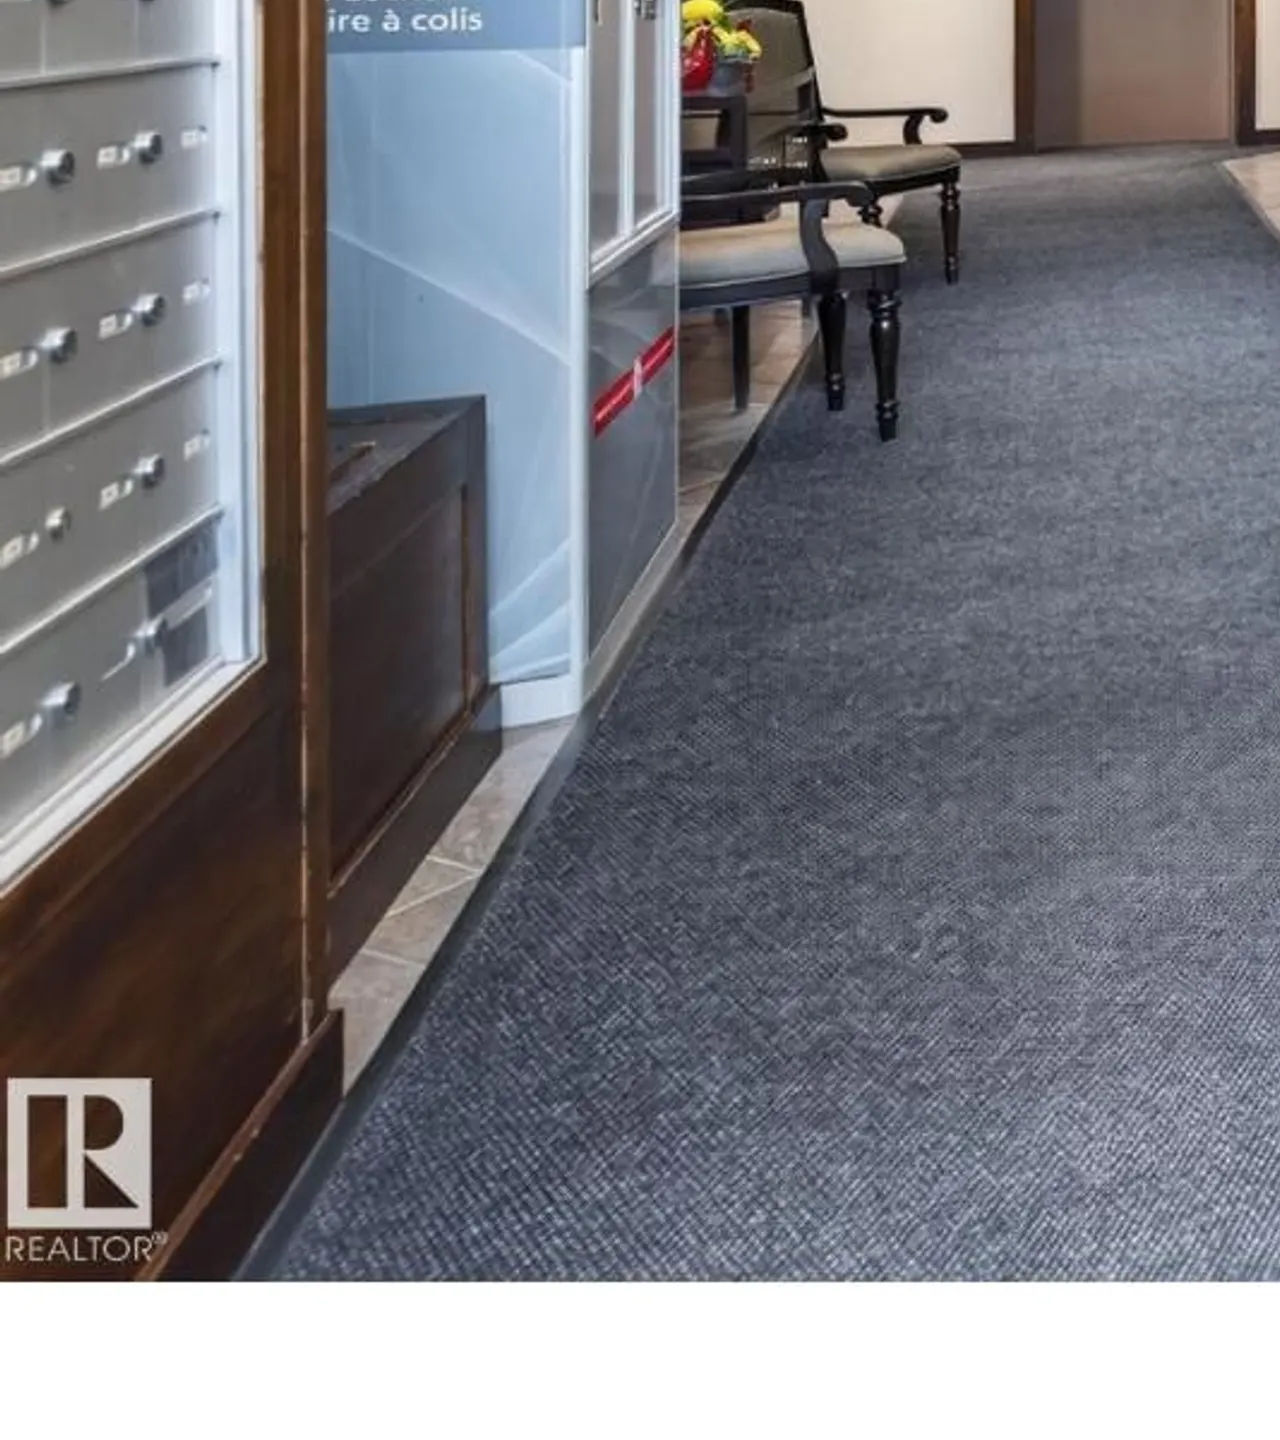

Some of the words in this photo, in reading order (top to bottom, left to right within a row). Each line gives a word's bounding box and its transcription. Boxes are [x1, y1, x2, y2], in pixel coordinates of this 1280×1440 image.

[327, 8, 372, 33] ire
[381, 8, 400, 33] à
[411, 7, 483, 32] colis
